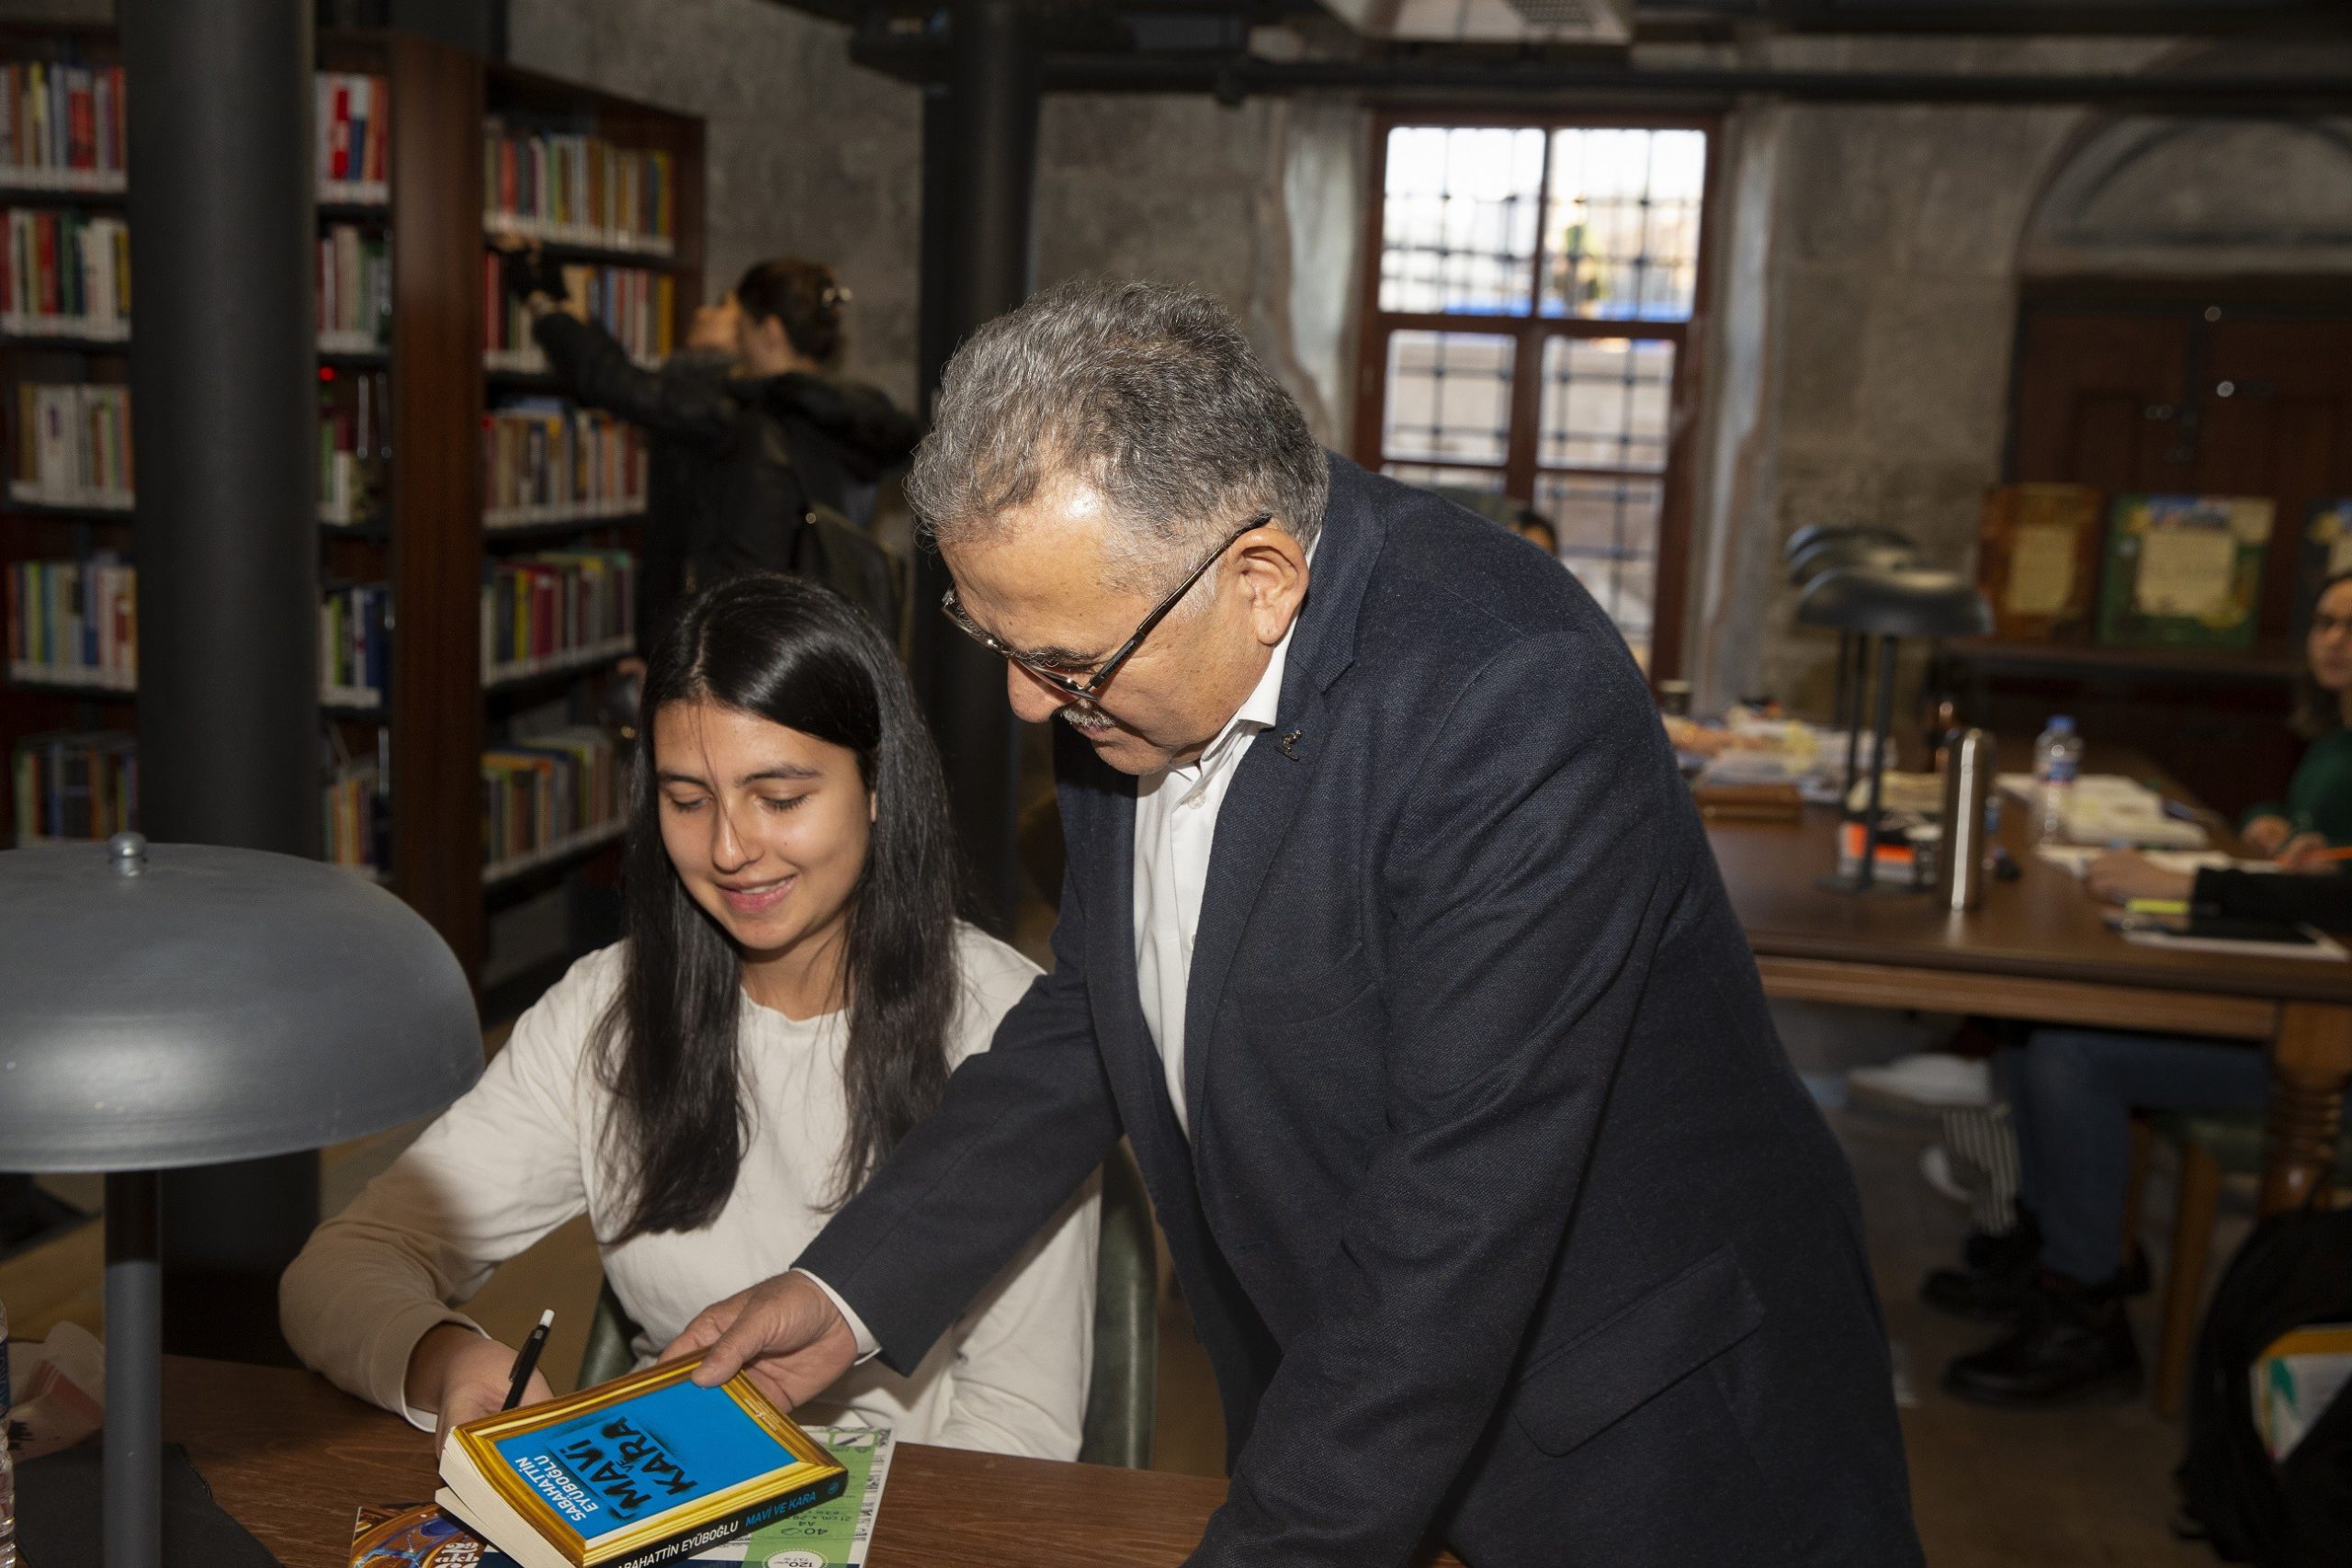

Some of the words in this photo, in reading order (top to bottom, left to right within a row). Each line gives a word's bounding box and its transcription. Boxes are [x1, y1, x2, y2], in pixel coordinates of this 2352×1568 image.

[534, 1455, 599, 1513] EYÜBOĞLU
[559, 1439, 652, 1509] MAVİ
[603, 1416, 698, 1495] KARA
[514, 1456, 586, 1521] SABAHATTİN
[745, 1506, 772, 1527] MAVİ
[774, 1502, 787, 1516] VE
[788, 1491, 817, 1510] KARA
[618, 1543, 680, 1568] BAHATTİN
[681, 1520, 739, 1552] EYÜBOĞLU
